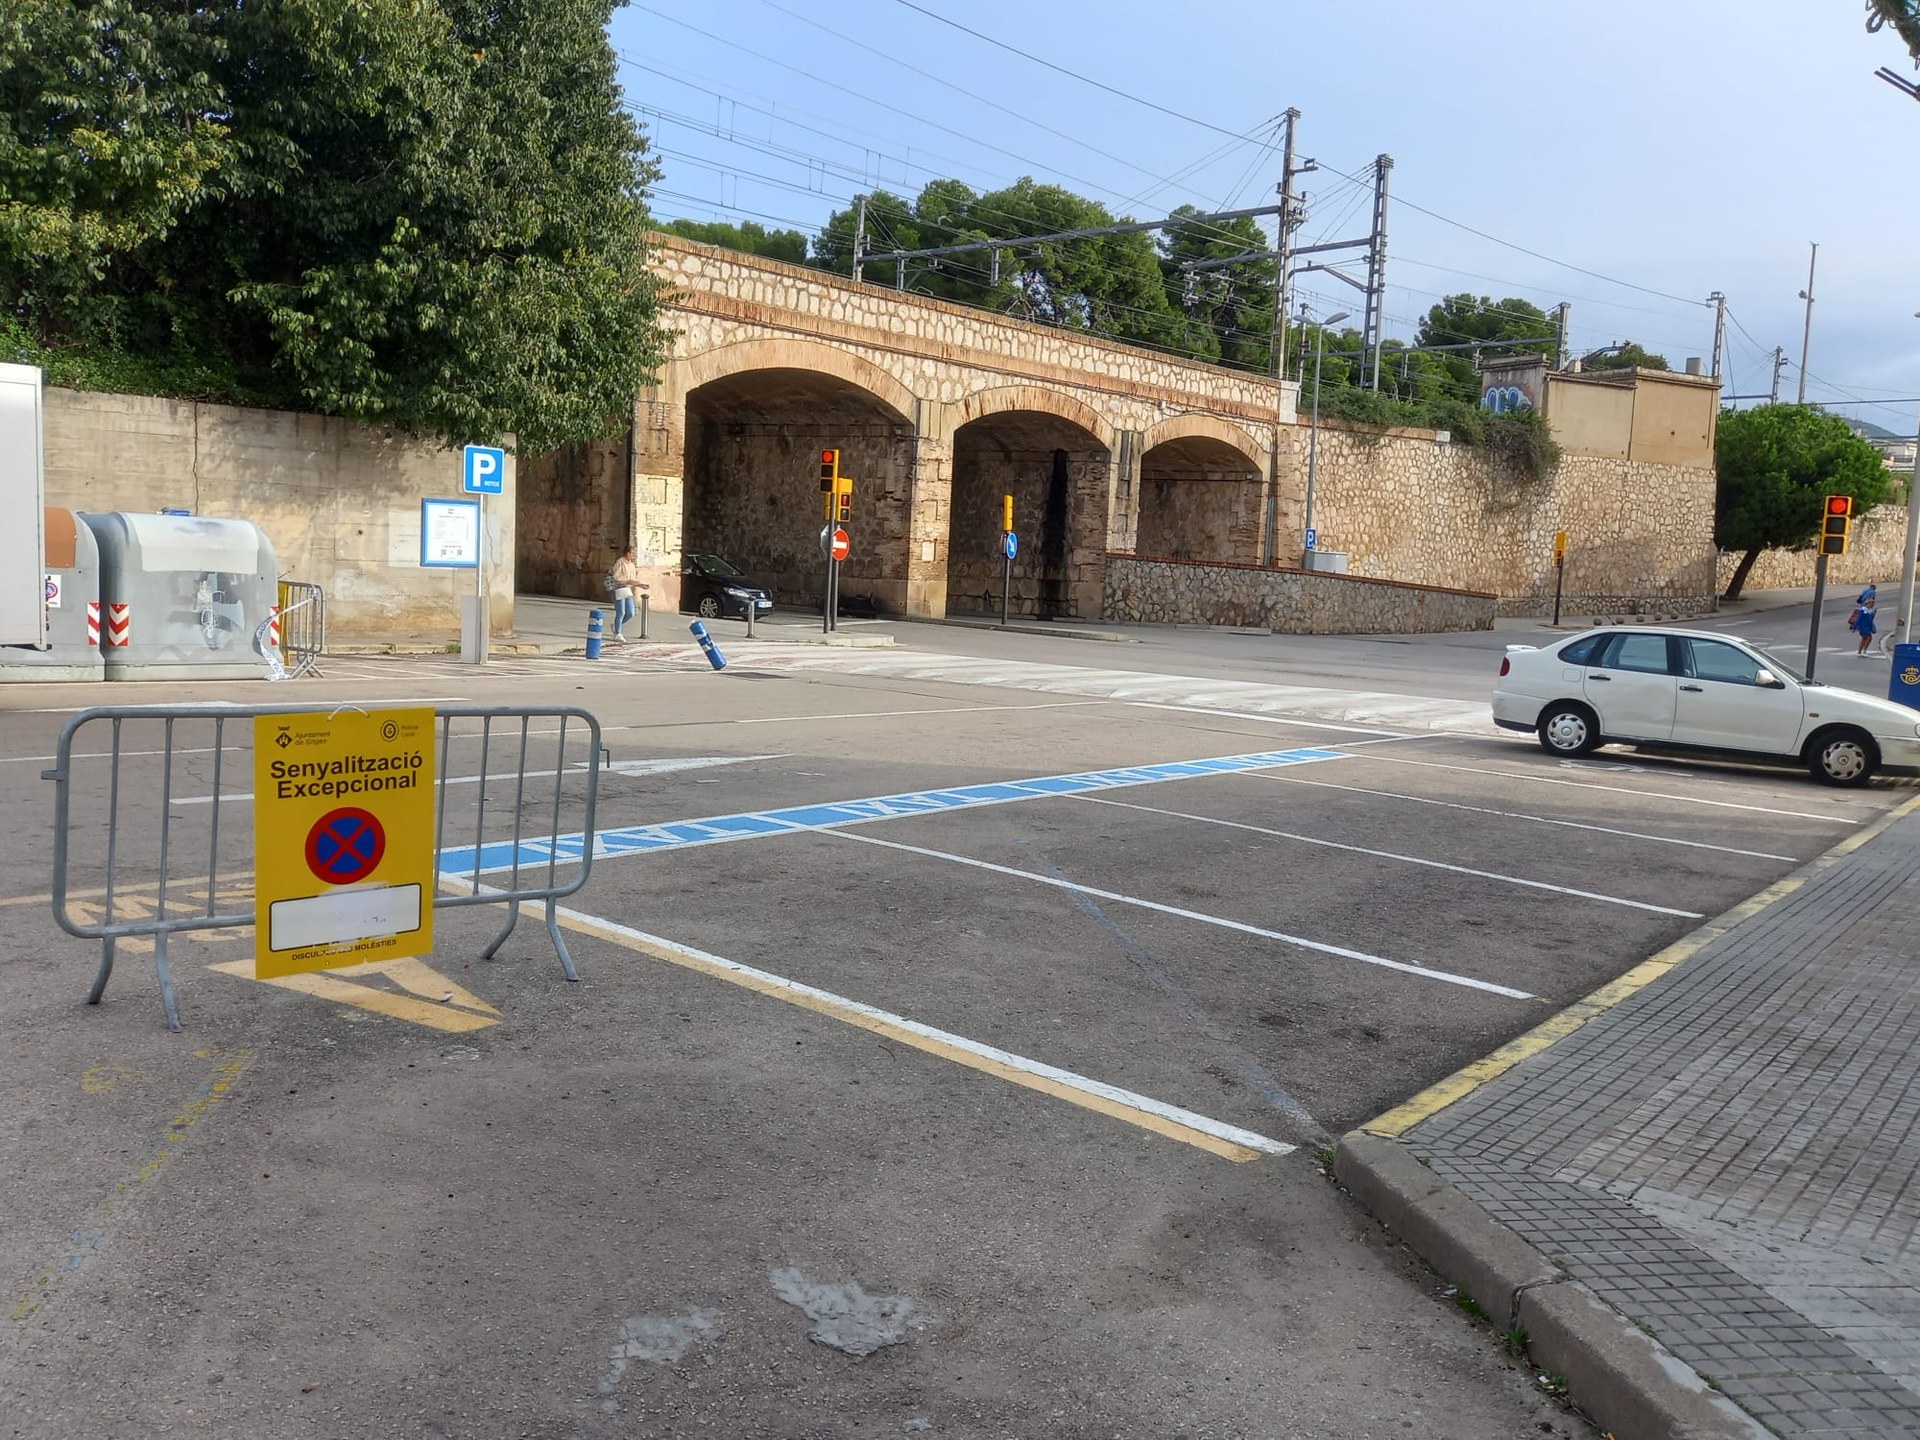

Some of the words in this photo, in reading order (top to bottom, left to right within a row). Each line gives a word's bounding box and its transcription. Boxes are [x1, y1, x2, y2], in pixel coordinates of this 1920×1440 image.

[473, 453, 496, 487] P
[270, 751, 423, 780] Senyalització
[277, 770, 417, 799] Excepcional
